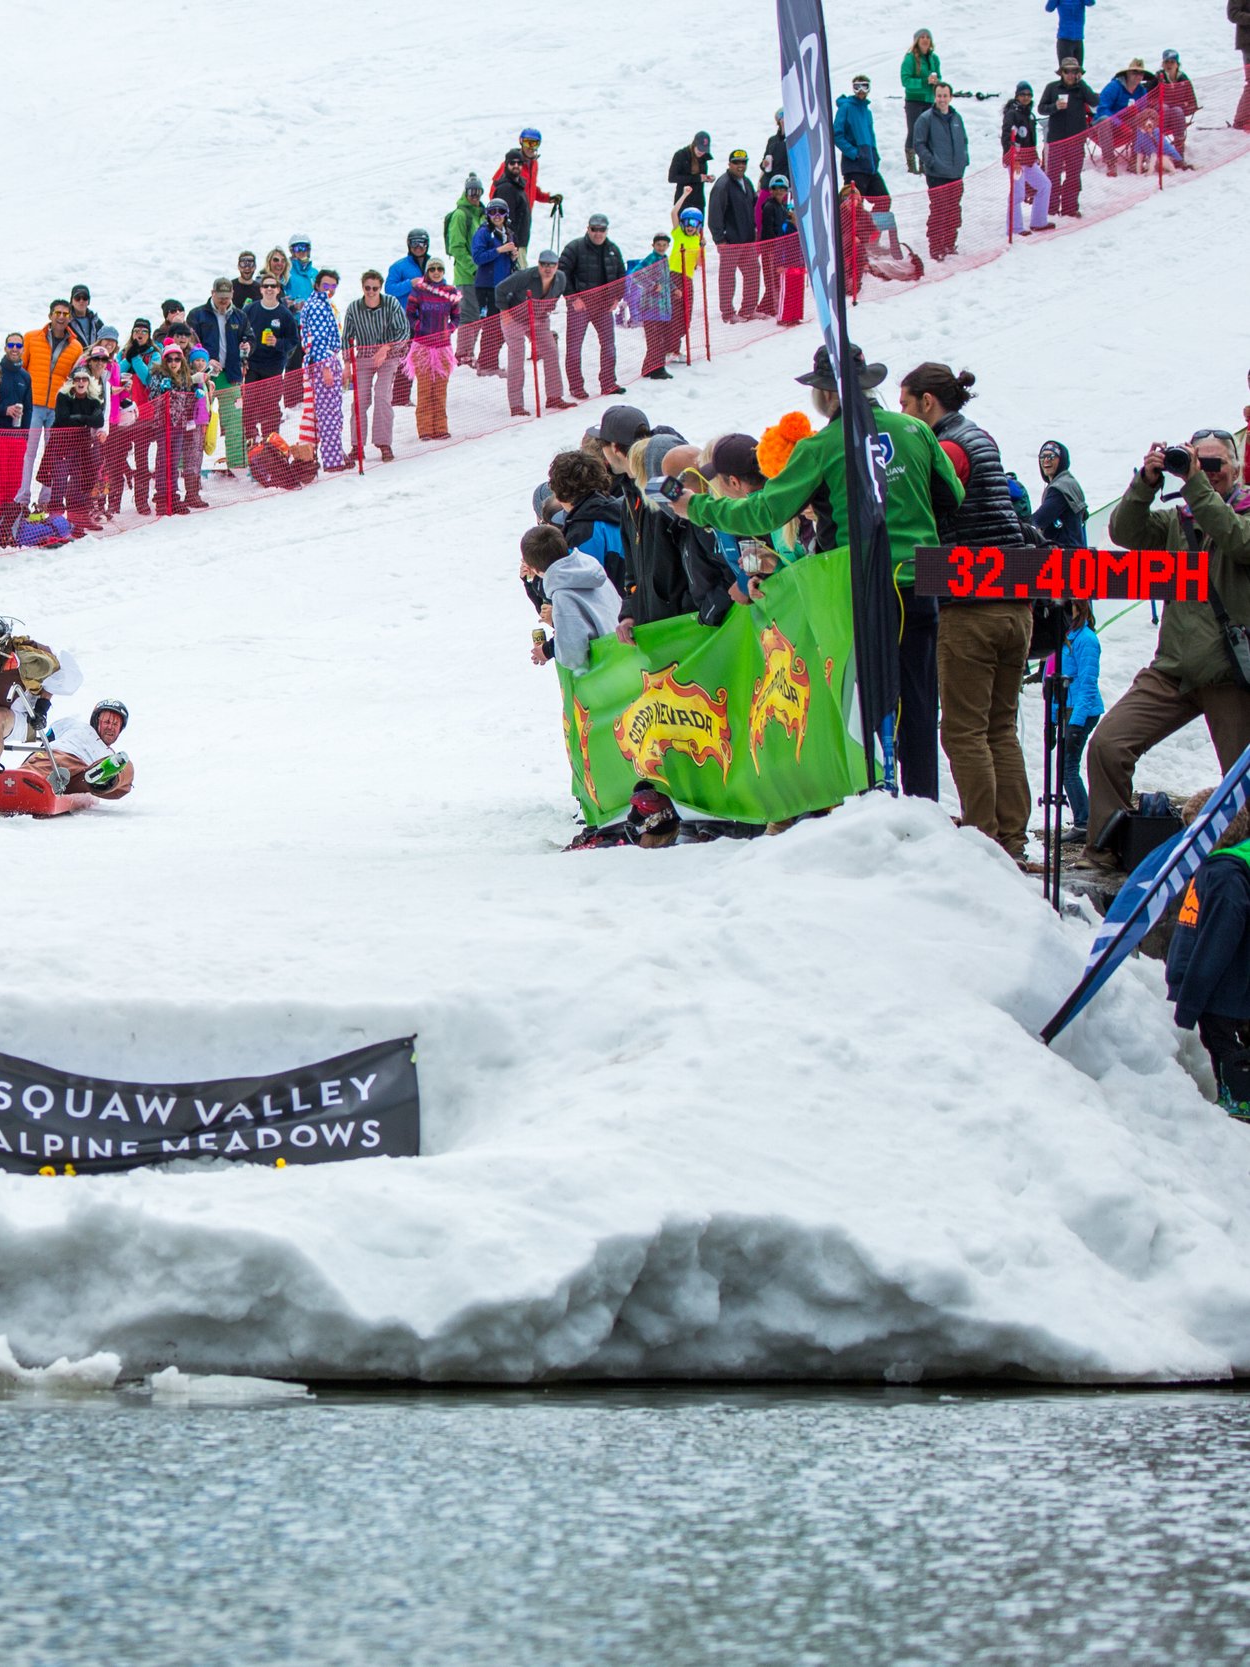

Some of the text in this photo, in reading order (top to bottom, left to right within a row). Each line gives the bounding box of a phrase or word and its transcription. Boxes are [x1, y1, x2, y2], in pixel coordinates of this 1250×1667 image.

[948, 546, 1209, 602] 32.40MPH
[654, 700, 713, 738] NEVADA
[193, 1073, 378, 1127] VALLEY
[161, 1119, 381, 1153] MEADOWS
